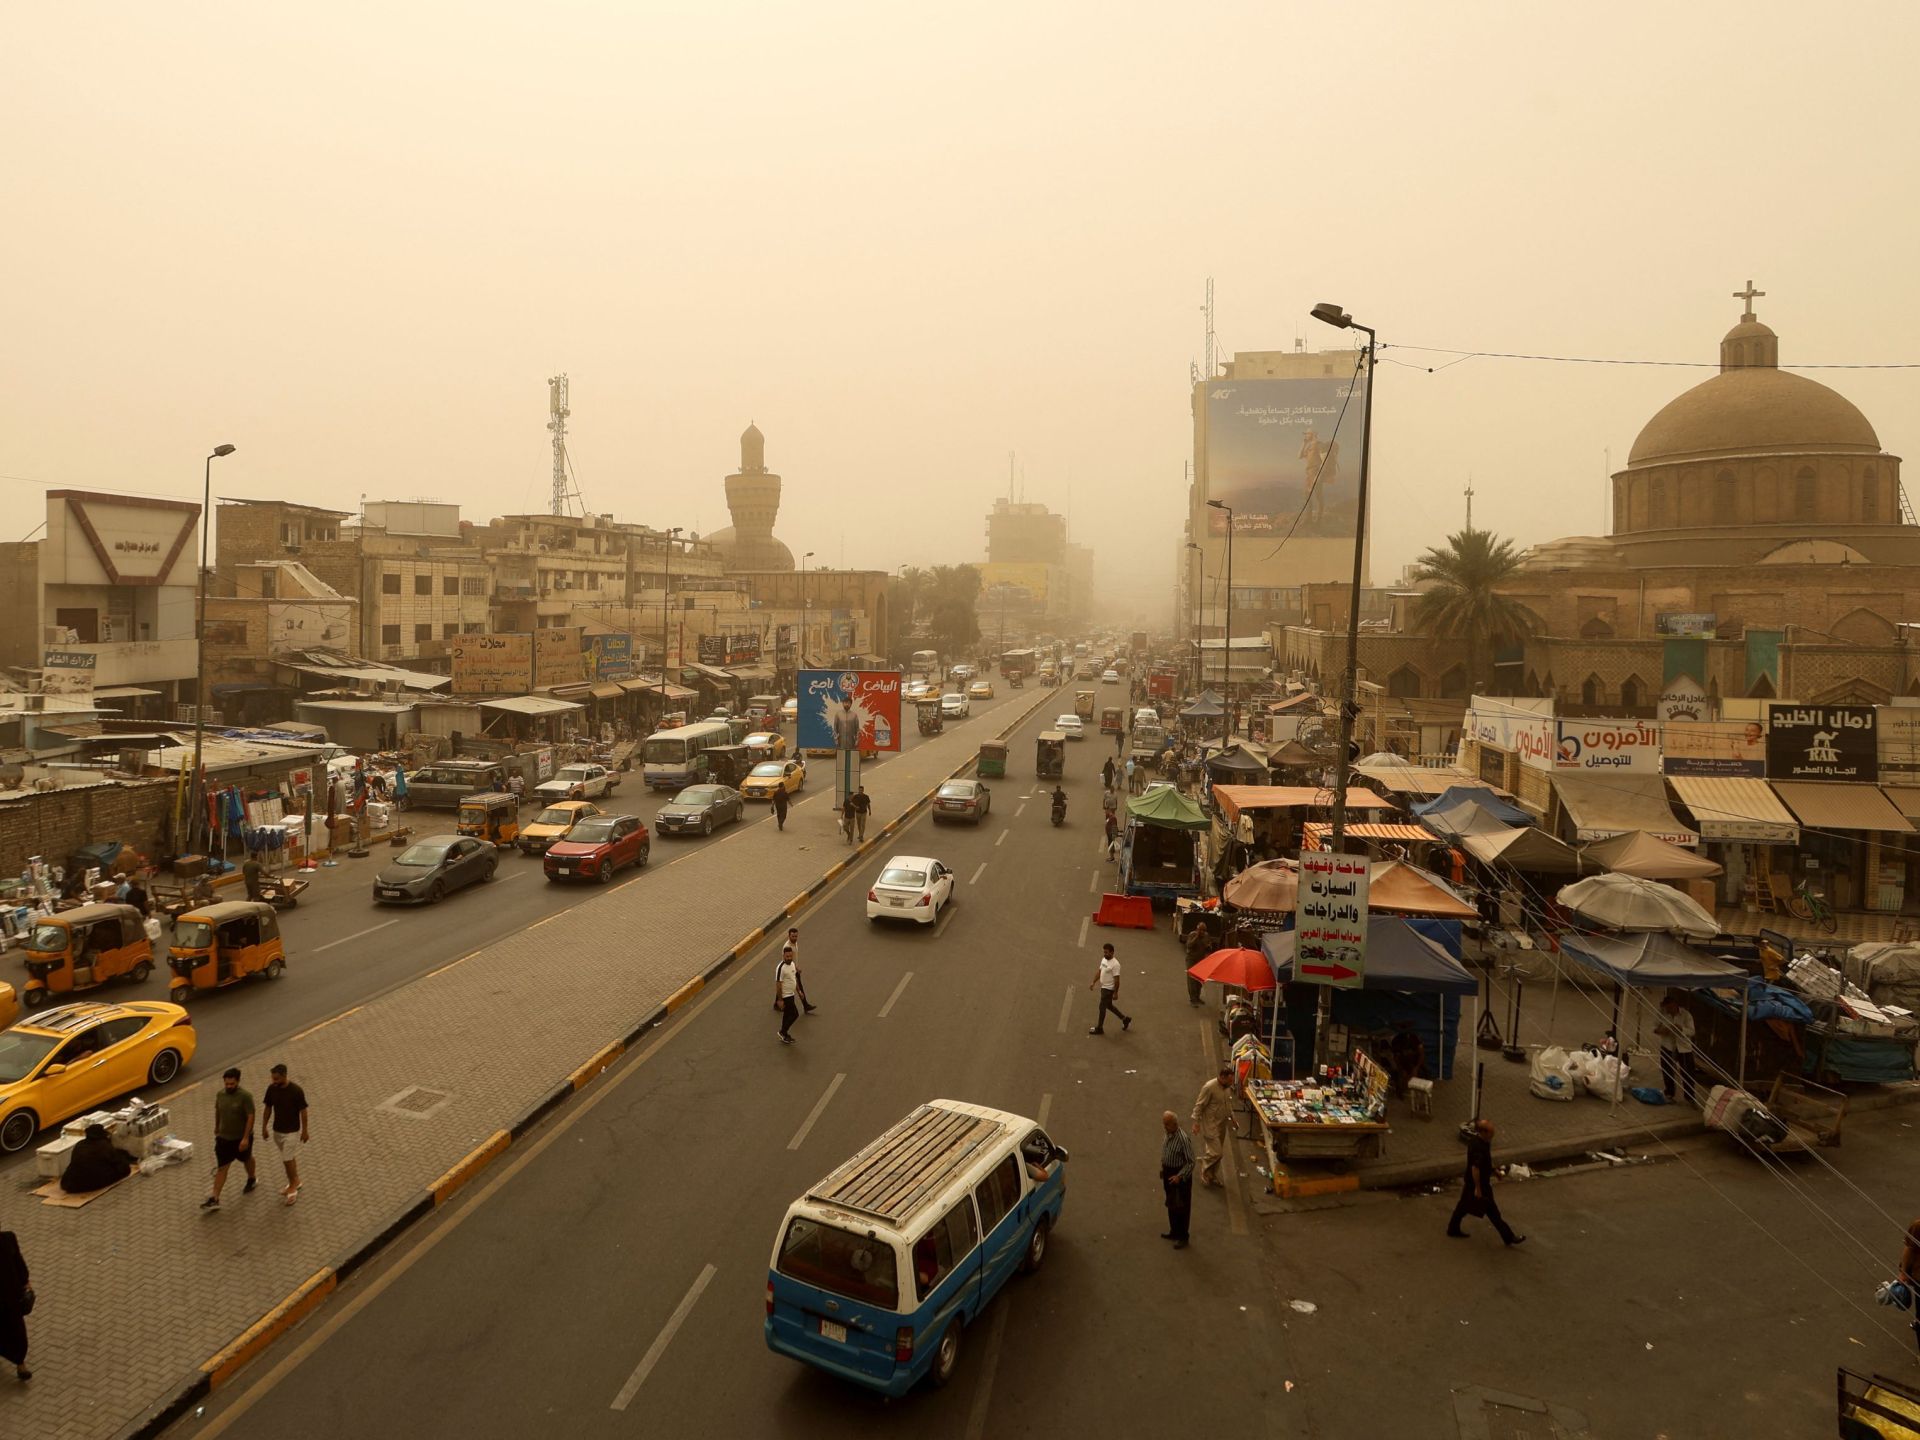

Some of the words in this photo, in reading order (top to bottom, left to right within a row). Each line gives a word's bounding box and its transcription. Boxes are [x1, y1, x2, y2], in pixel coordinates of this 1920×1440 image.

[454, 648, 464, 659] 2
[808, 677, 833, 695] ناصع
[864, 679, 897, 693] البياض
[1666, 704, 1701, 715] PRIME
[1773, 709, 1823, 728] الخليج
[1829, 711, 1872, 730] رمال
[1515, 719, 1552, 760] الأمزون
[1583, 720, 1655, 750] الأمزون
[1585, 754, 1631, 768] للتوصيل
[1808, 749, 1838, 762] RAK
[1303, 857, 1333, 874] وقوف
[1336, 858, 1365, 875] ساحة
[1304, 901, 1358, 923] والدراجات
